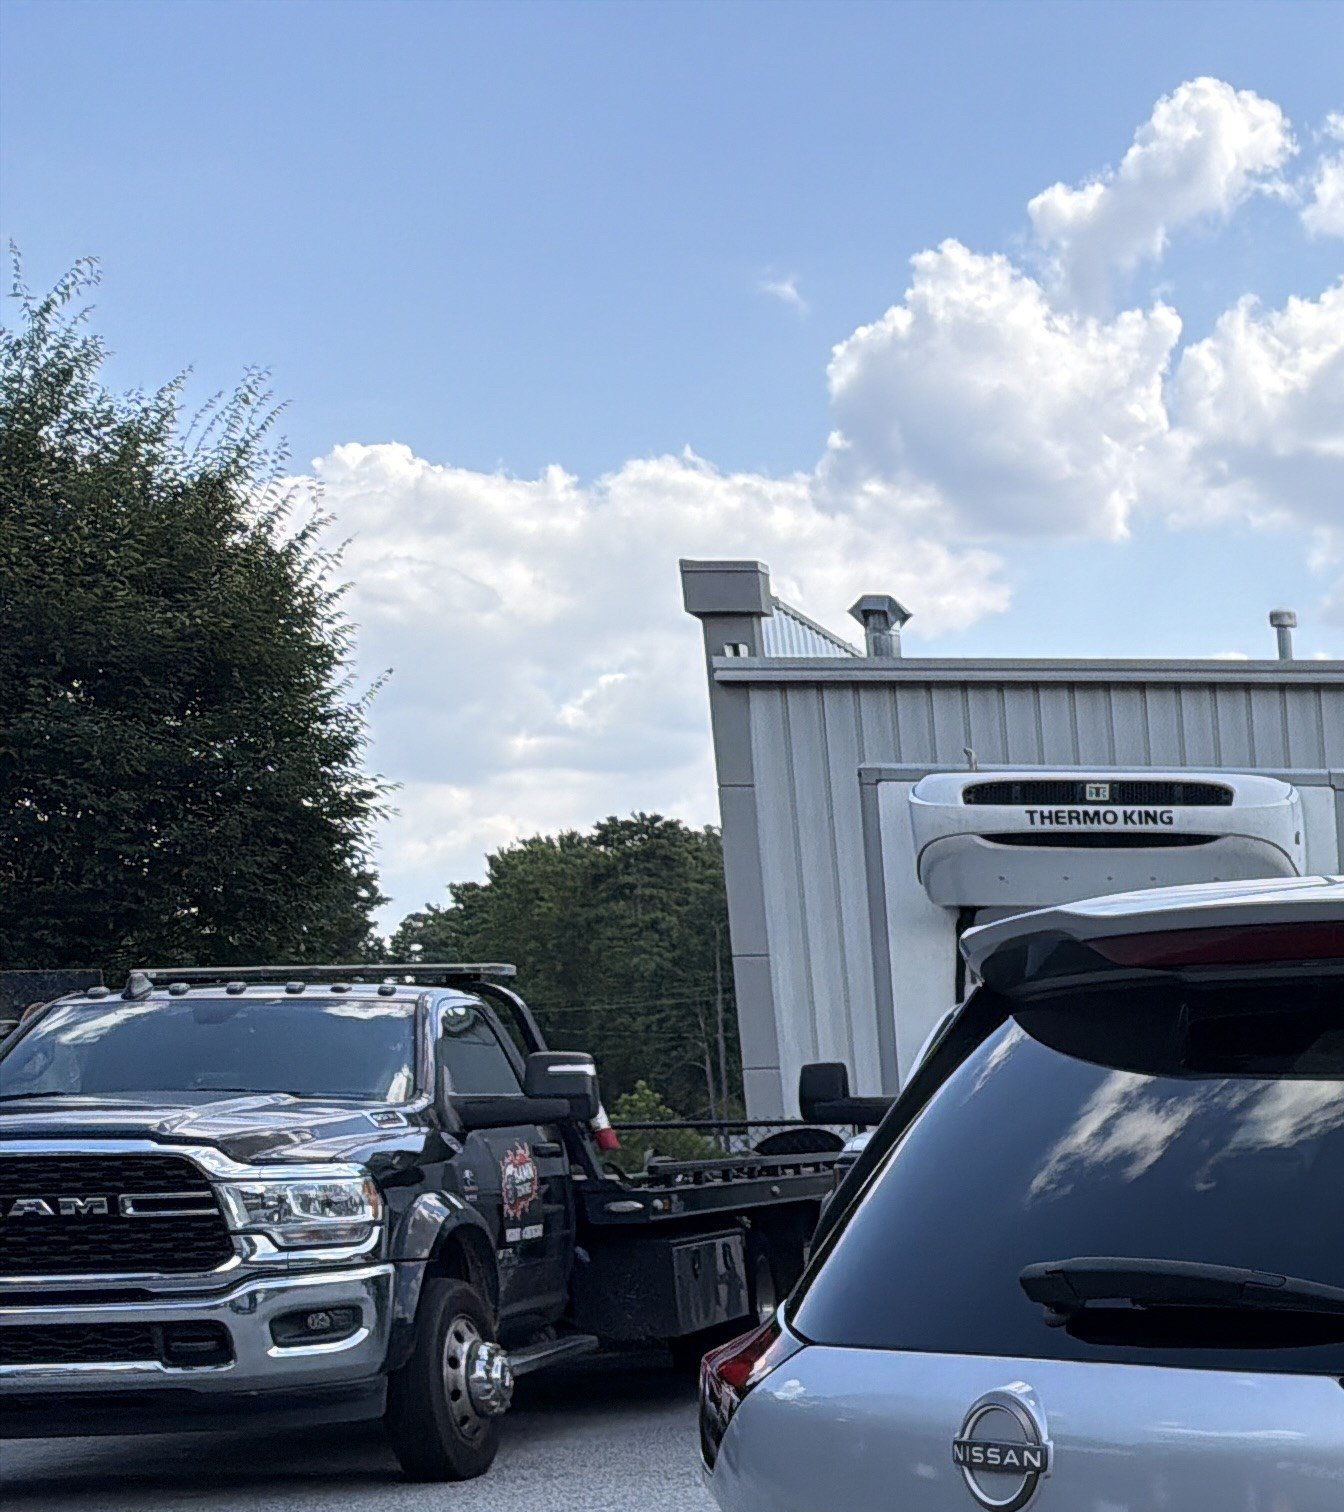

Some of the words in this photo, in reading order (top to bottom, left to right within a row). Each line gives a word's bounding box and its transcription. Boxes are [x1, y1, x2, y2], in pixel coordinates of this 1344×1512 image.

[1025, 809, 1119, 826] THERMO
[1123, 809, 1175, 826] KING
[0, 1197, 109, 1216] AM
[953, 1443, 1041, 1468] NISSAN
